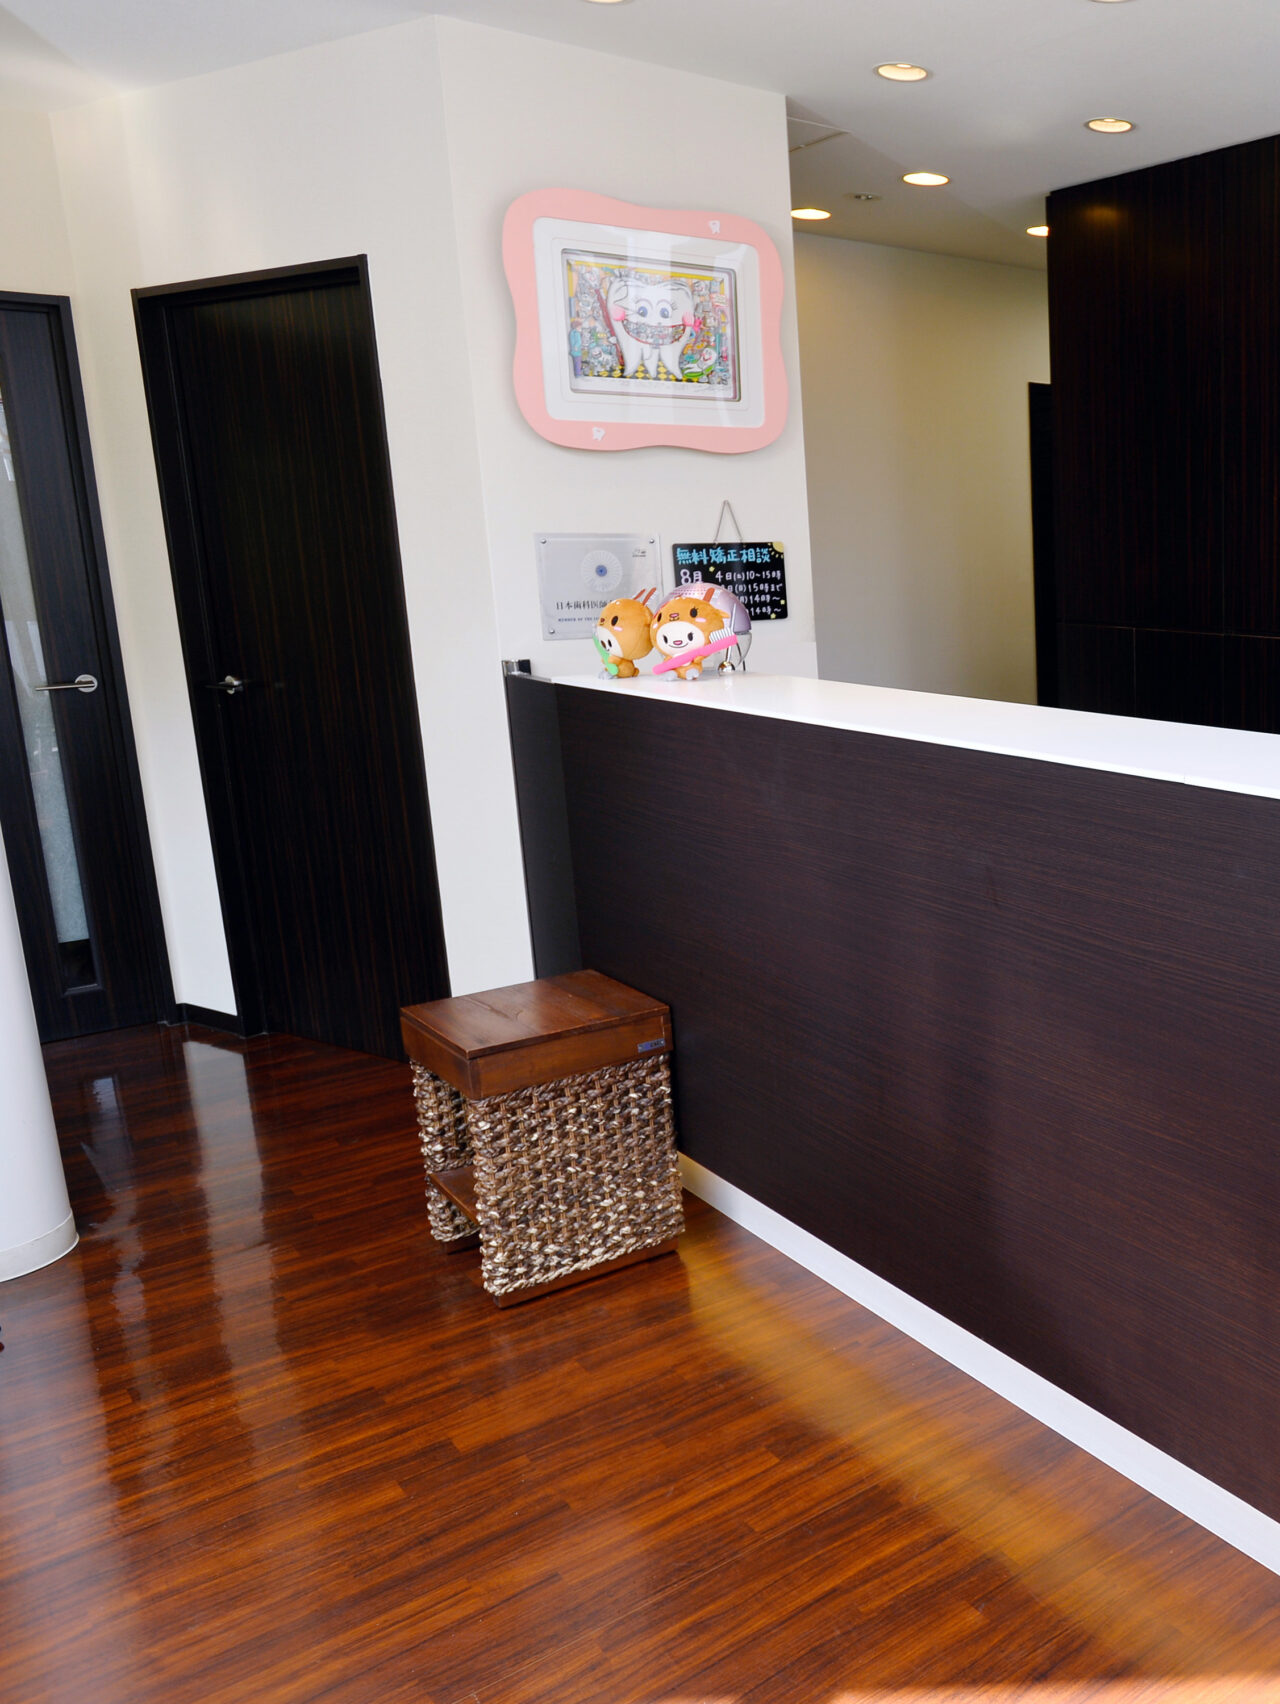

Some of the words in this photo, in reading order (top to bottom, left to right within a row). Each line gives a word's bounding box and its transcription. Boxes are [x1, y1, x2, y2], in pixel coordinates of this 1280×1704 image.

[676, 546, 770, 564] 無料矯正相談
[680, 569, 702, 585] 8月
[556, 600, 612, 610] 日本歯科医師
